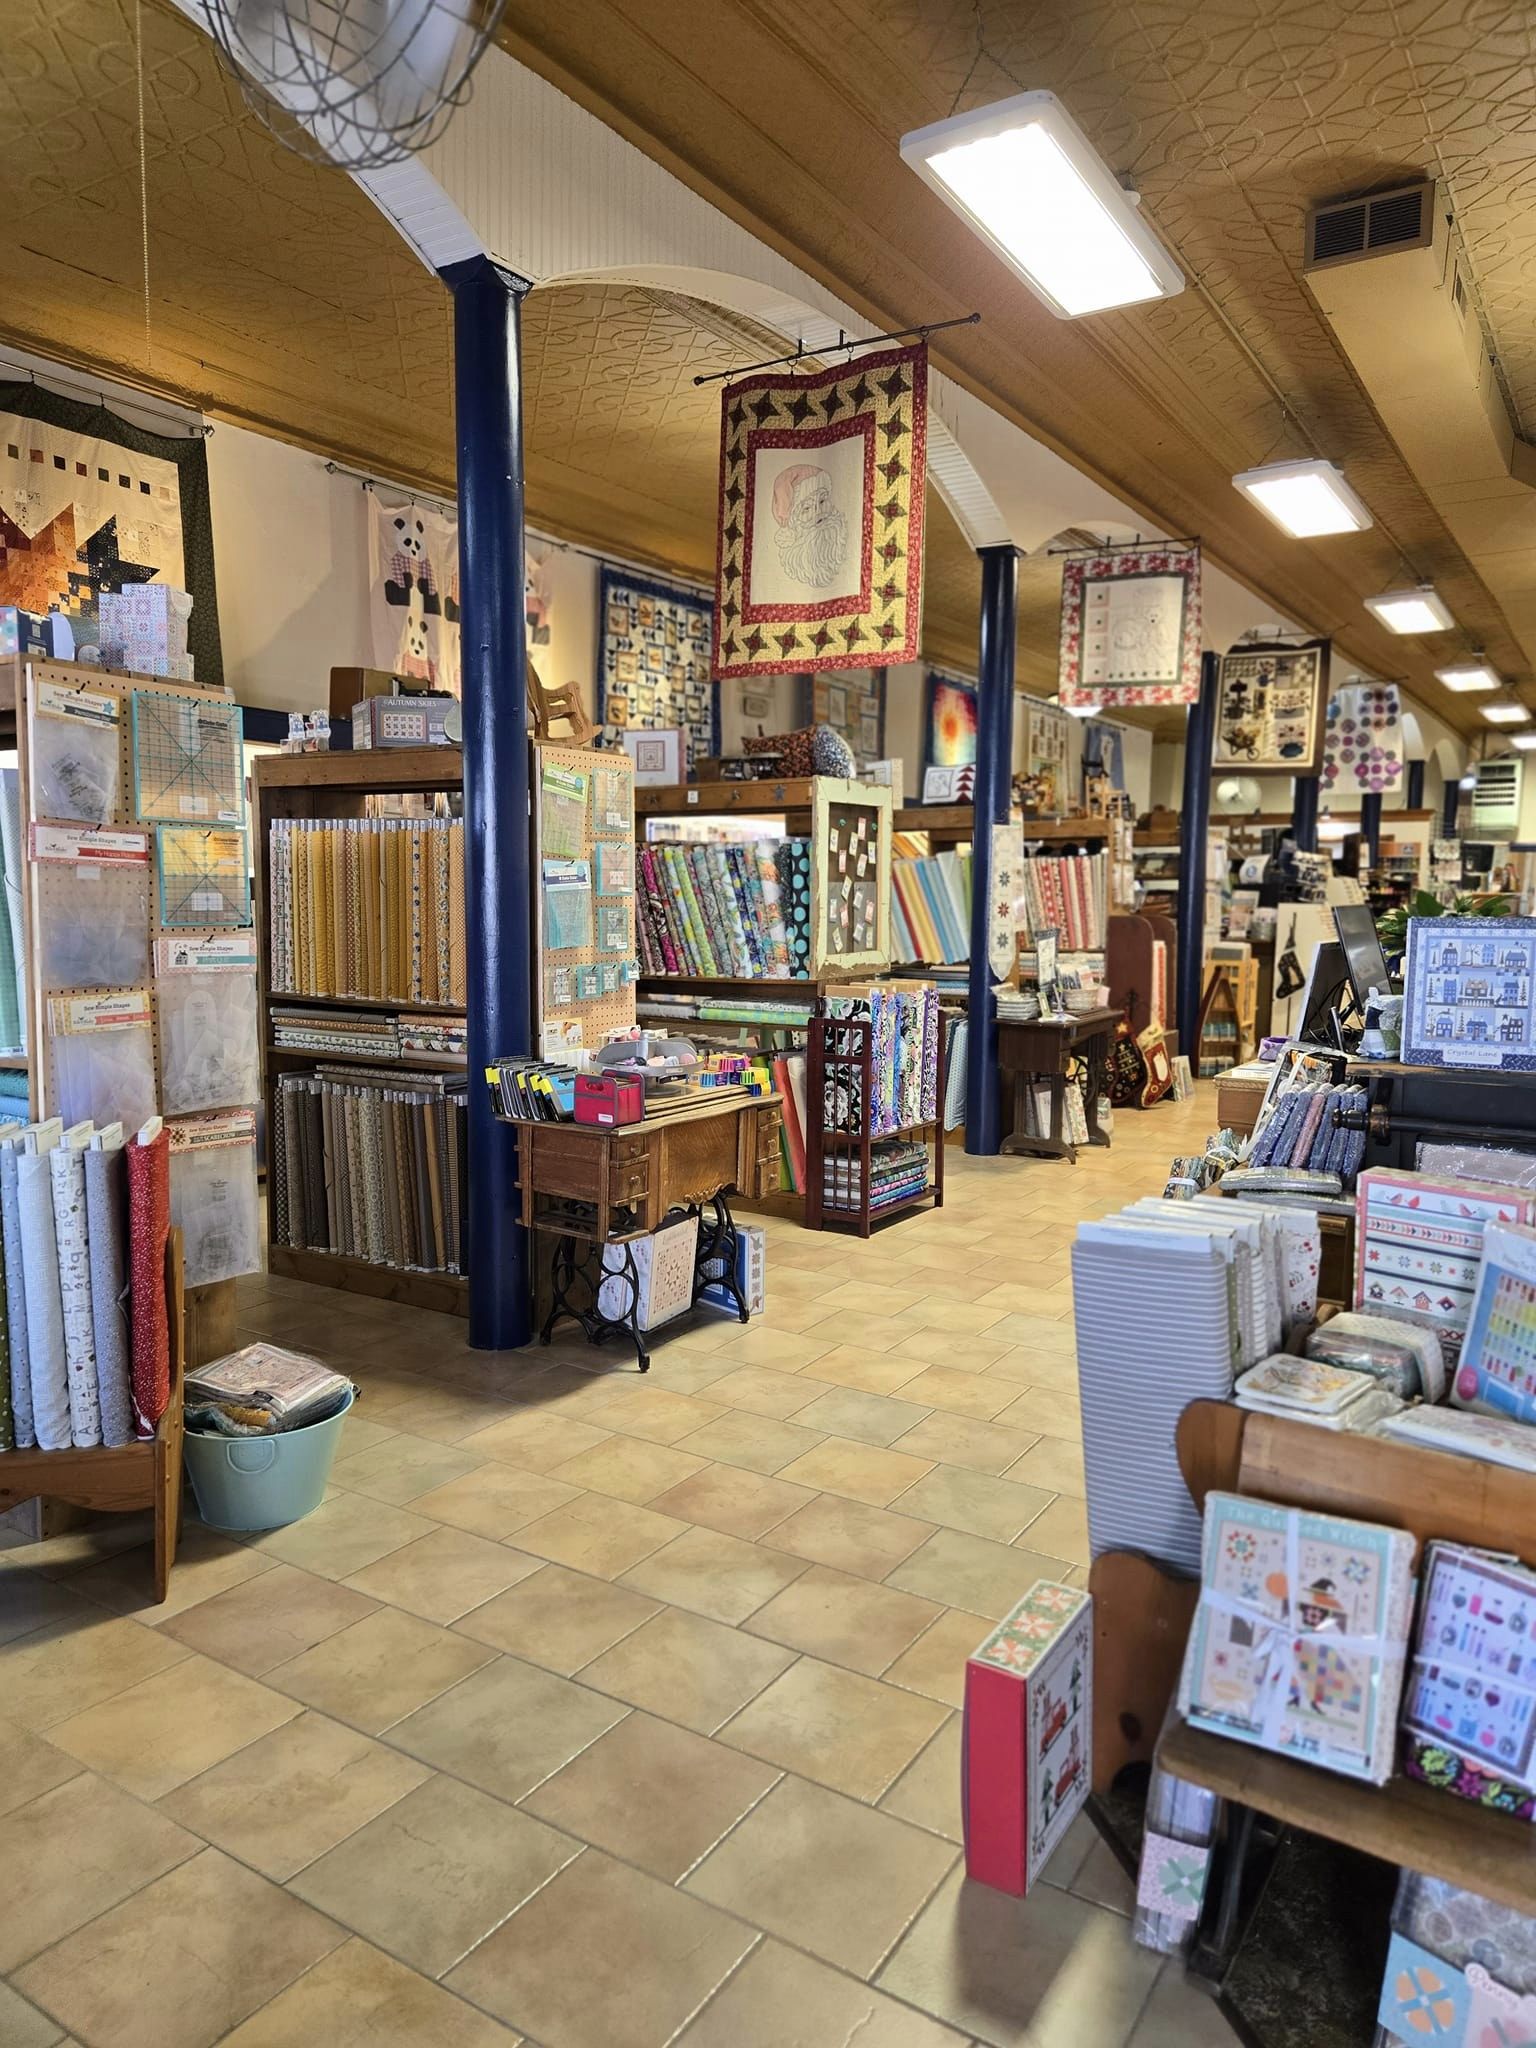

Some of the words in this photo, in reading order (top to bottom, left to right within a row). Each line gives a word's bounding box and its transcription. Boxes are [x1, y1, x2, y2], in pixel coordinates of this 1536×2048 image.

[1446, 1049, 1476, 1057] Crystal
[1478, 1050, 1498, 1058] Lane
[1229, 1505, 1256, 1521] The
[1330, 1526, 1378, 1549] Witch
